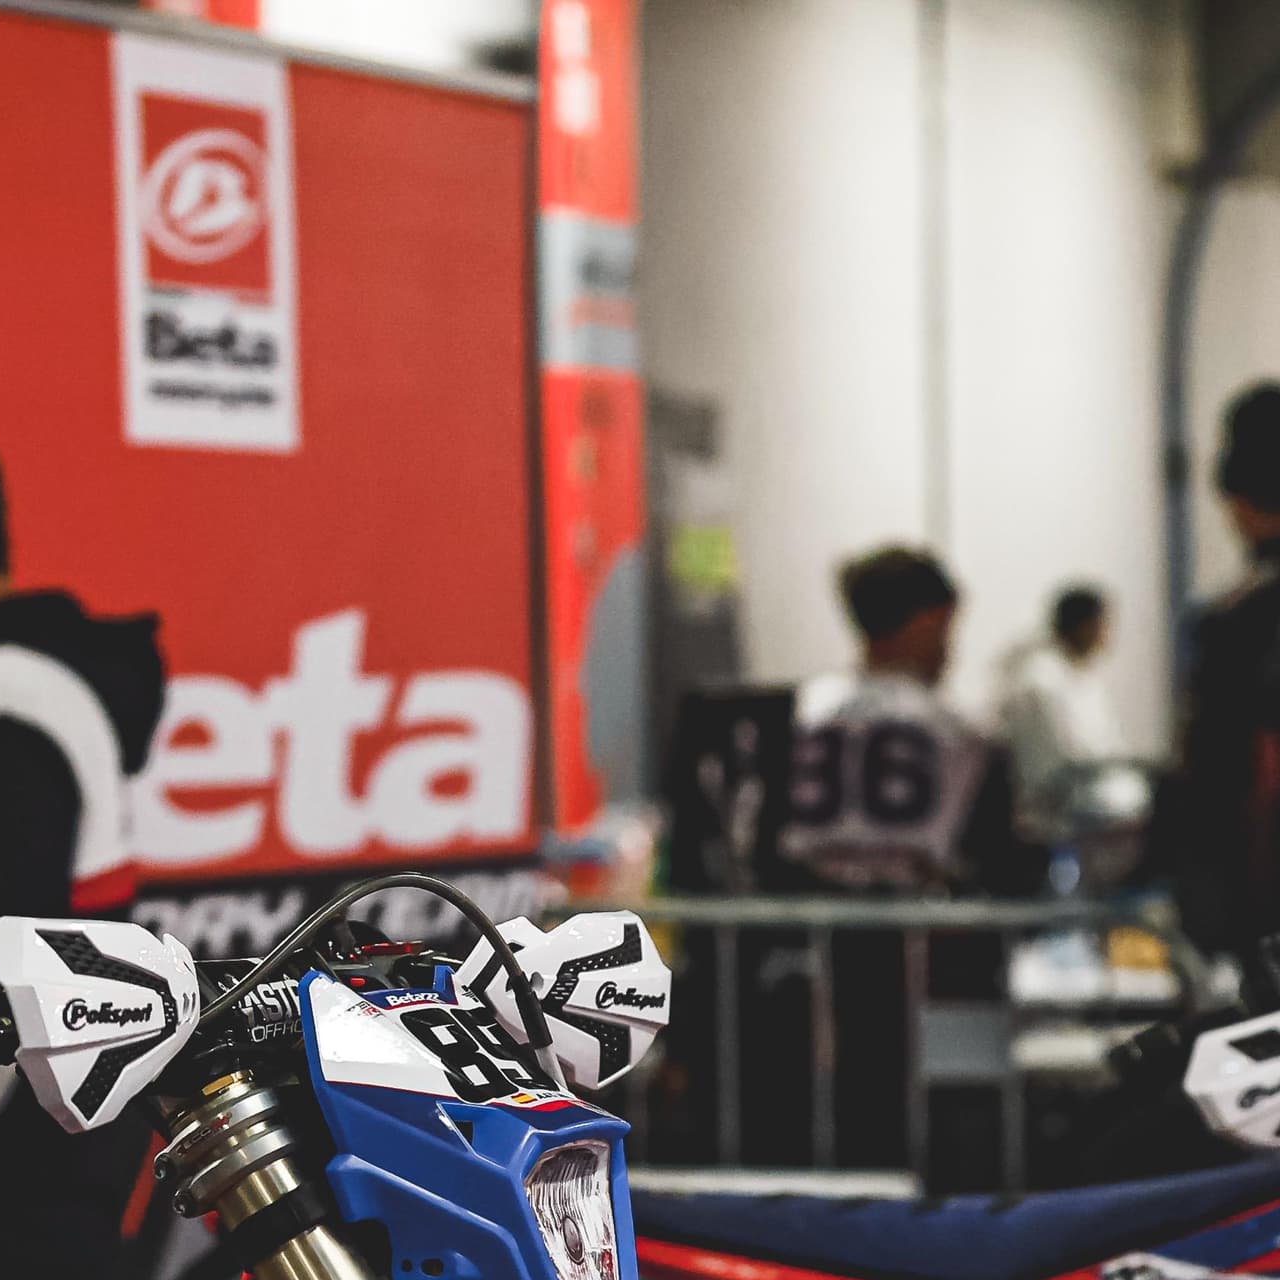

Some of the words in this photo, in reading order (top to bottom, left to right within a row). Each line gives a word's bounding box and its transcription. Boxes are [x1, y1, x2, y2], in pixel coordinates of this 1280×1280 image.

[595, 980, 666, 1010] Polisport
[62, 997, 153, 1031] Polisport
[399, 1006, 560, 1104] 89
